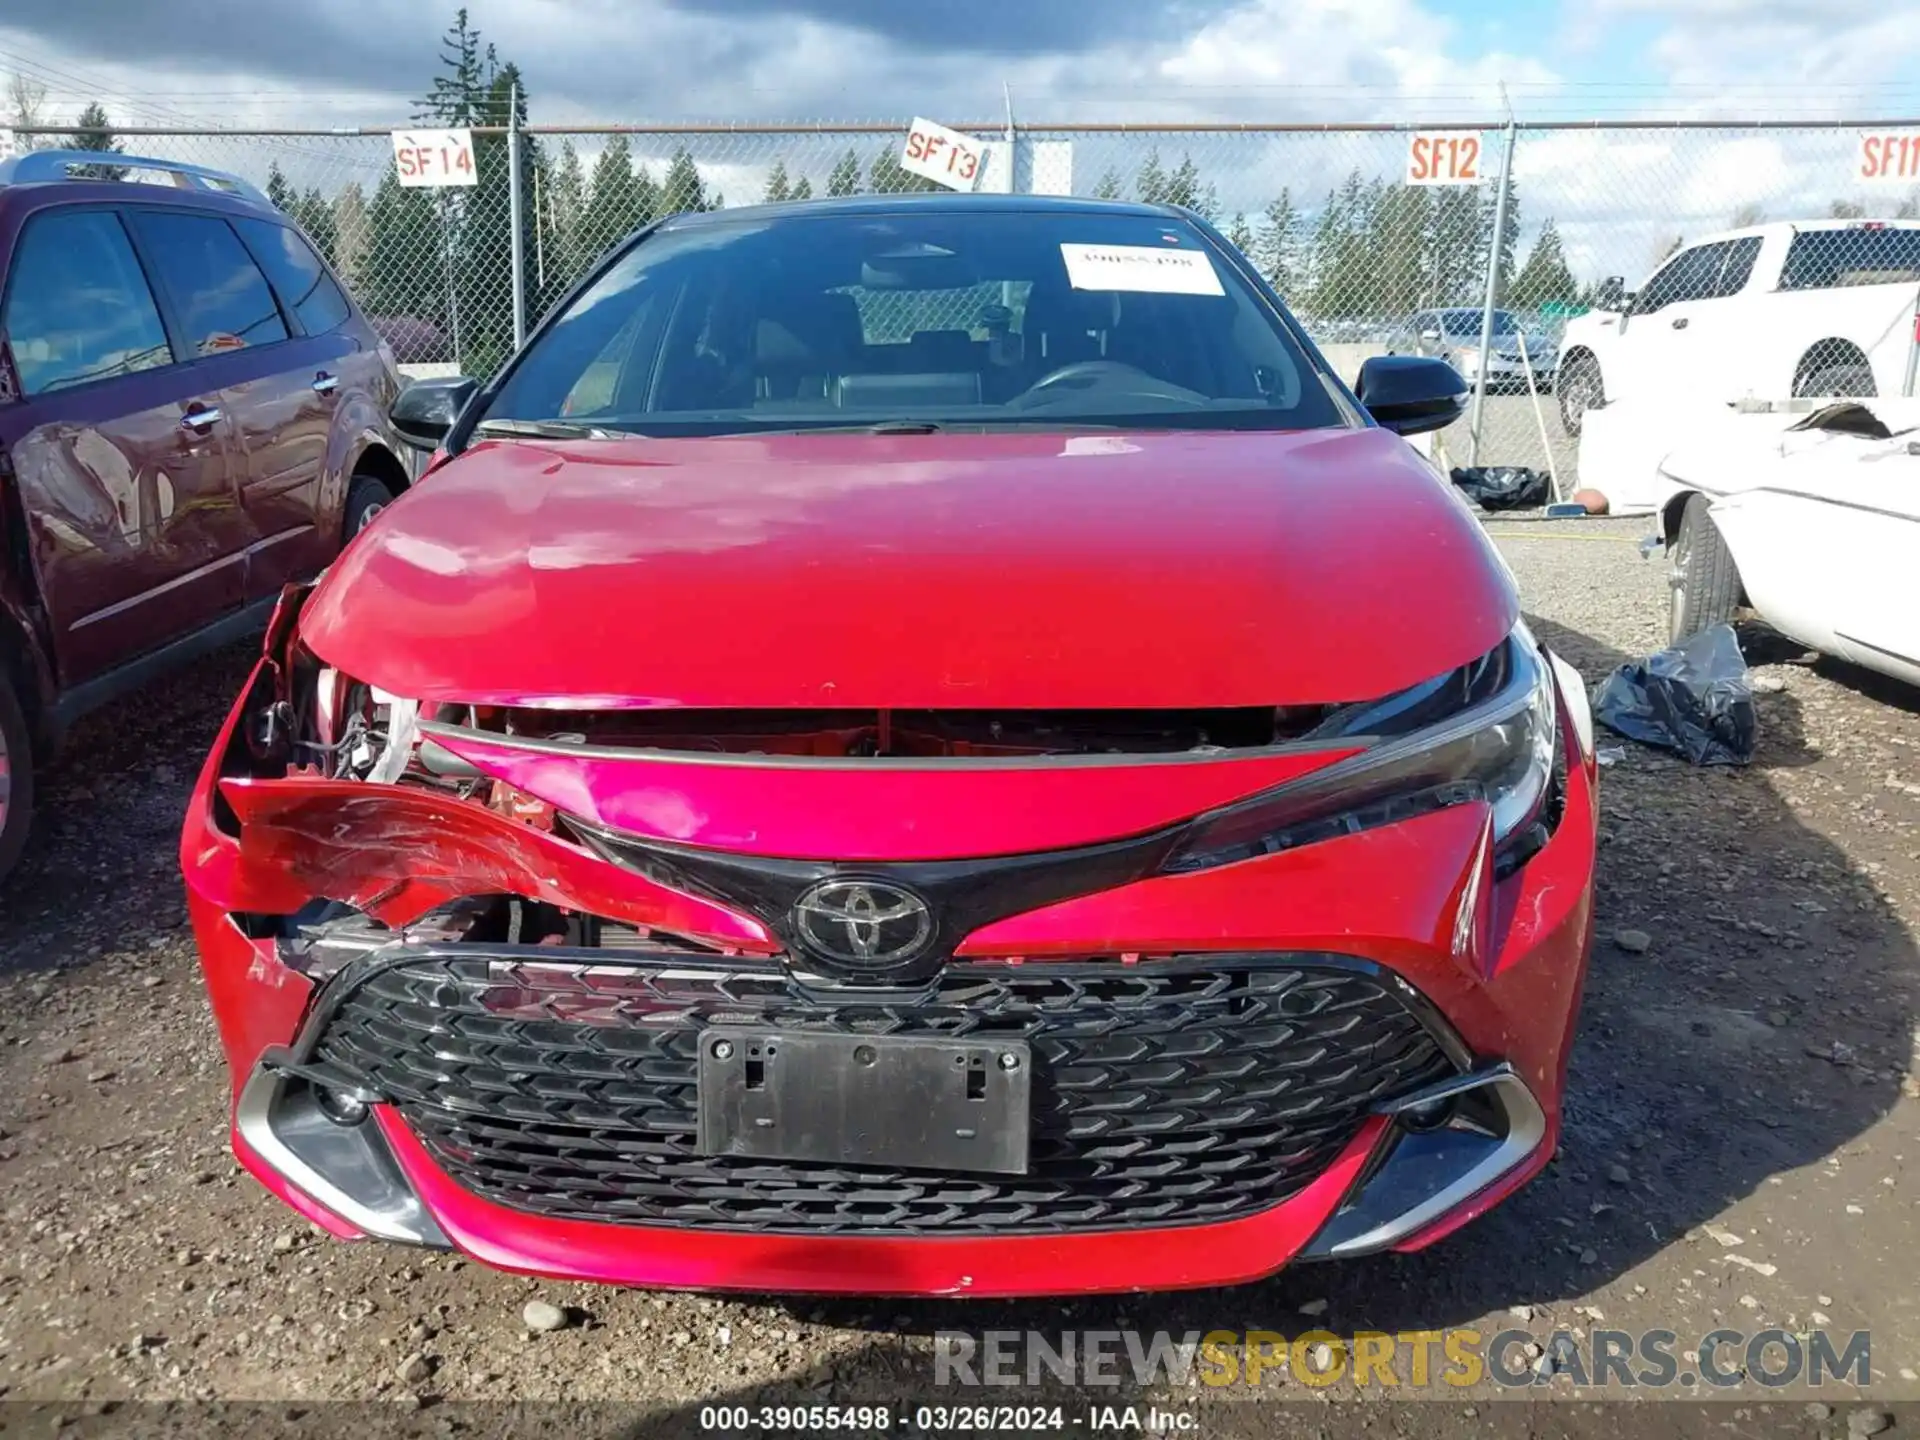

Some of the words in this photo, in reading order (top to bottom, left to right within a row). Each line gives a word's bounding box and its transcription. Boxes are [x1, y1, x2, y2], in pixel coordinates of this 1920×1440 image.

[398, 147, 432, 176] SF
[441, 147, 472, 175] 14
[906, 132, 949, 162] SF
[947, 147, 977, 179] 13
[1411, 137, 1479, 179] SF12
[1861, 136, 1920, 177] SF11
